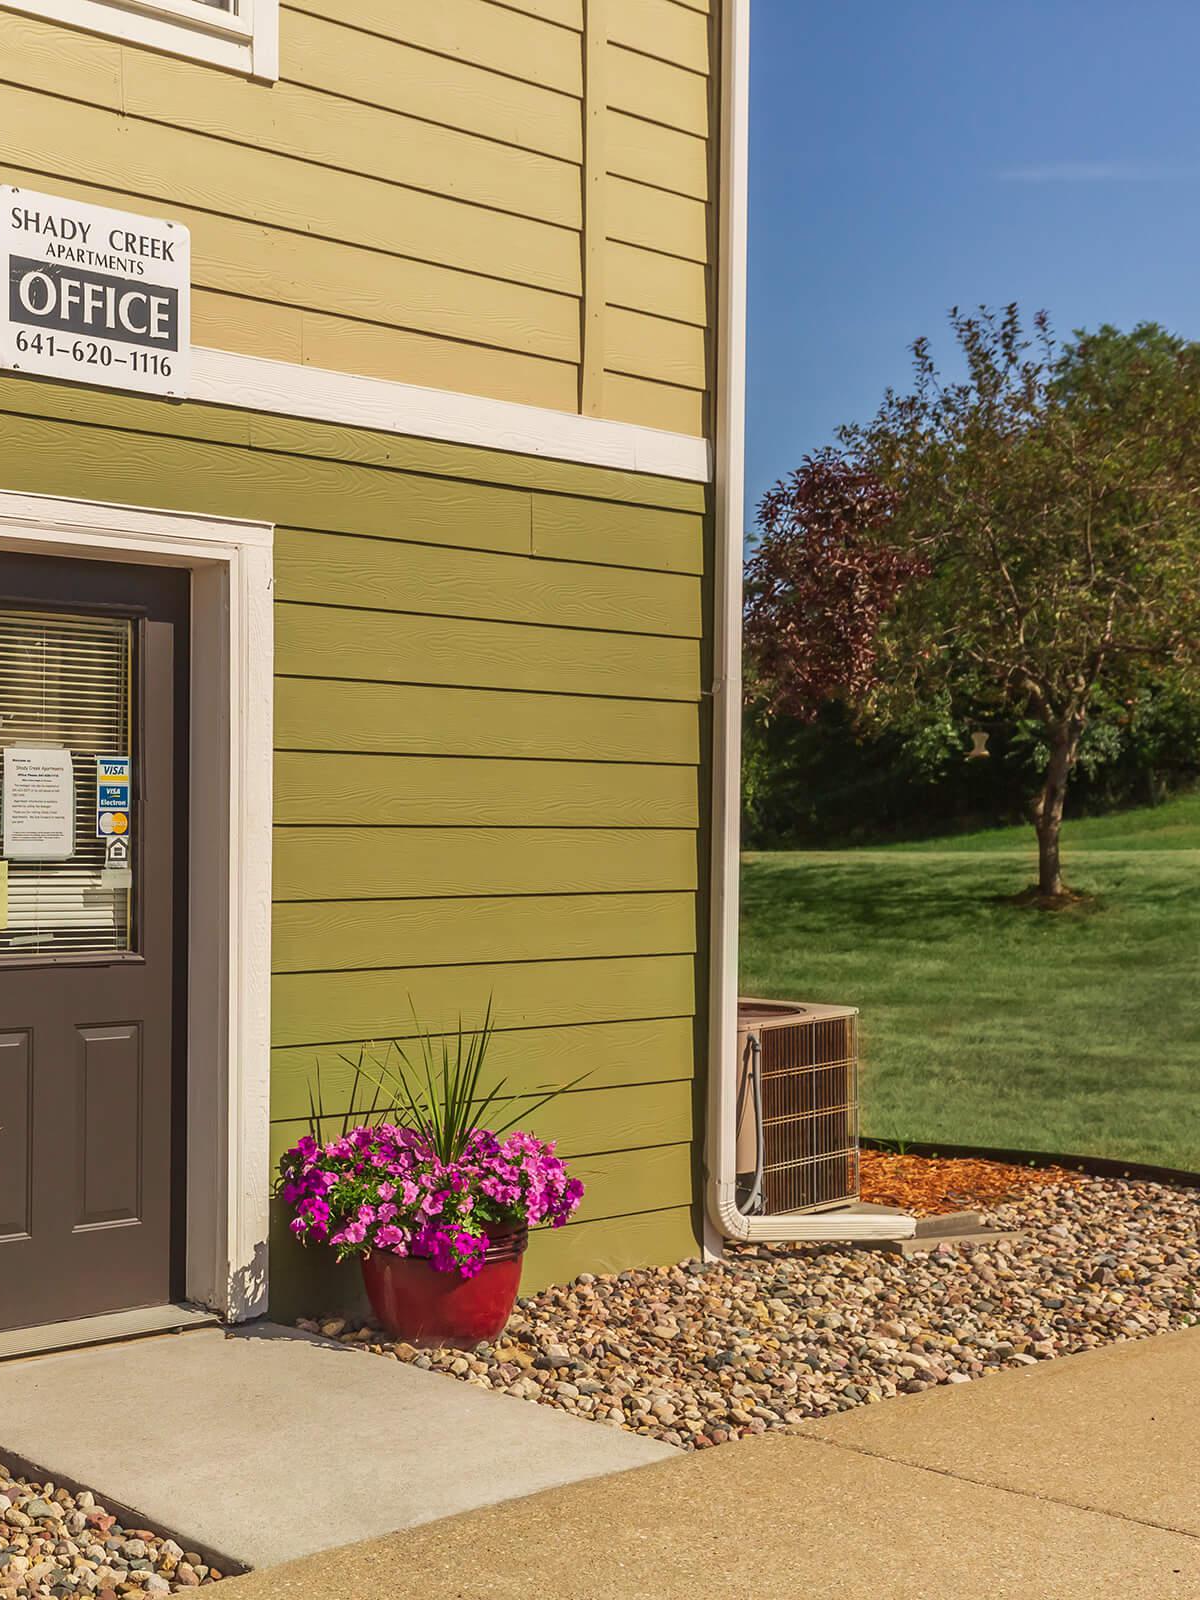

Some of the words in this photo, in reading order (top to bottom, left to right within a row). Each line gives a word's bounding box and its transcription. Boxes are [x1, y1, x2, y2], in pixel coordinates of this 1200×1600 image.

[11, 207, 91, 243] SHADY
[109, 229, 175, 262] CREEK
[45, 242, 144, 275] APARTMENTS
[19, 271, 170, 339] OFFICE
[16, 330, 171, 377] 641-620-1116
[104, 765, 125, 775] VISA
